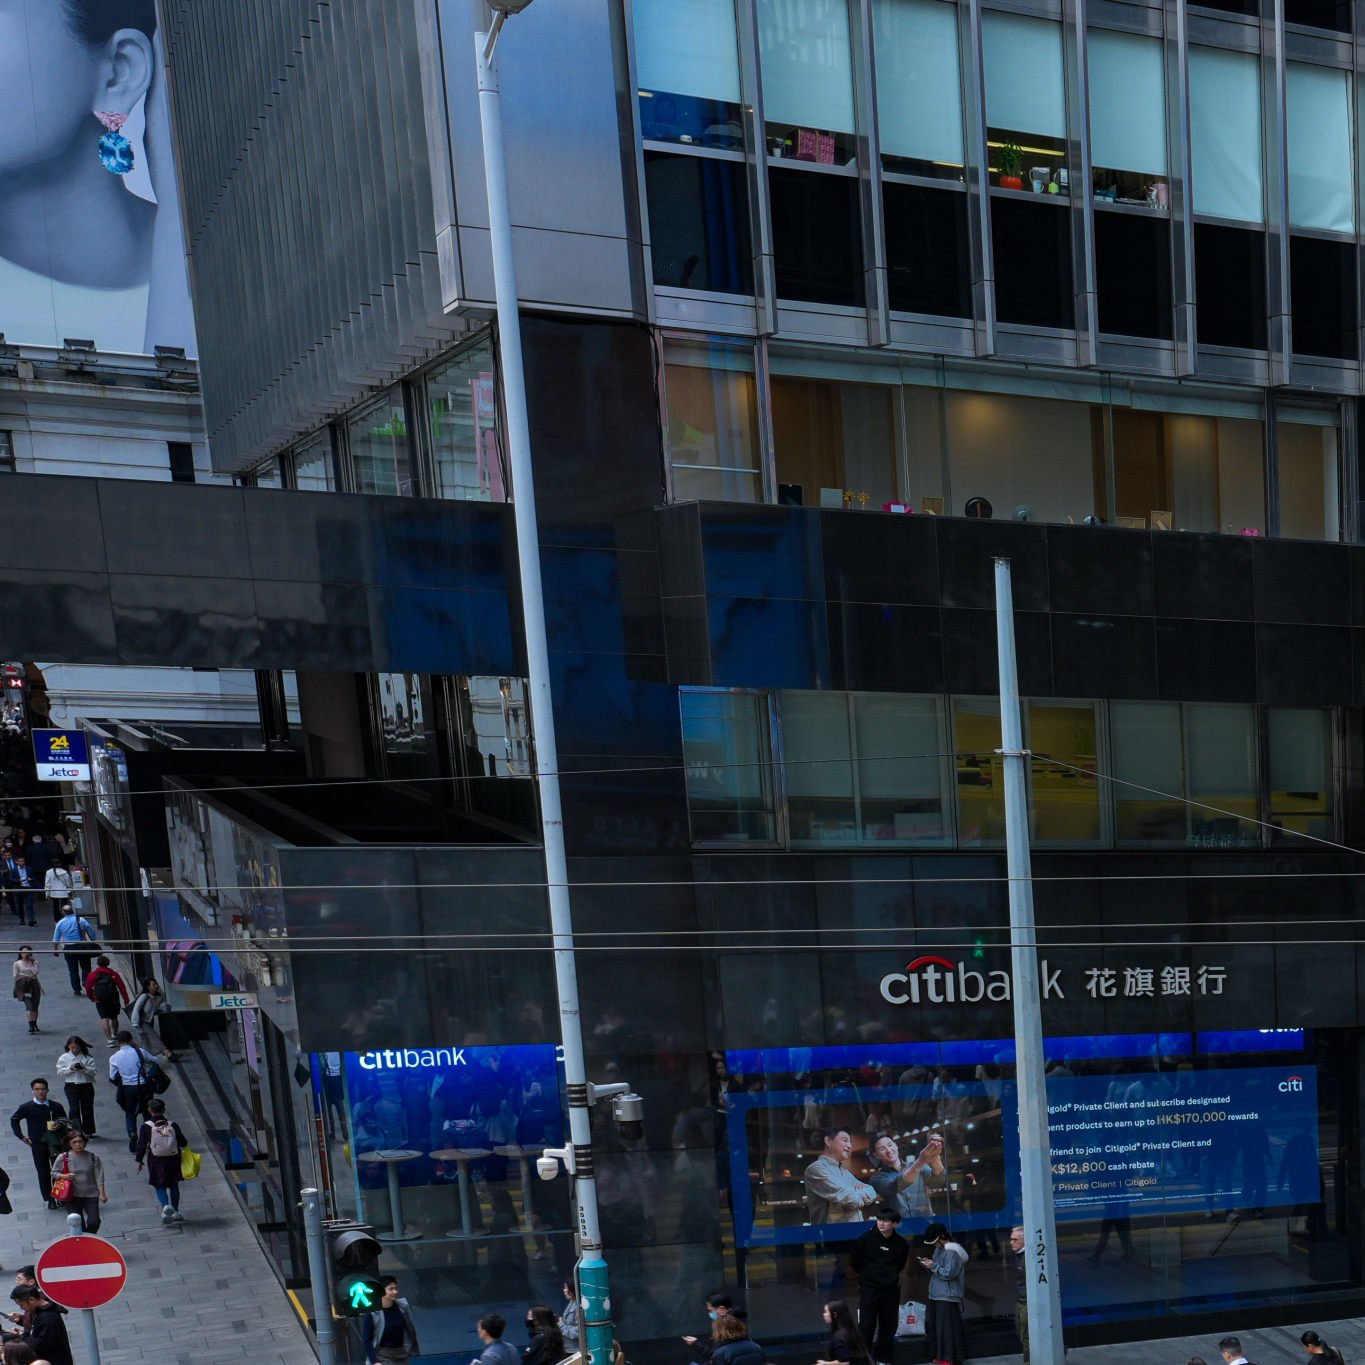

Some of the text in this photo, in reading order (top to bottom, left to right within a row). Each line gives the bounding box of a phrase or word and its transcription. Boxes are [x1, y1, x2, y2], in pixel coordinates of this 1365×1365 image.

[49, 735, 70, 749] 24
[880, 956, 1227, 1004] citibak 花旗銀行
[359, 1047, 467, 1070] citibank
[1278, 1077, 1303, 1092] citi
[1073, 1102, 1103, 1112] Private
[1103, 1101, 1128, 1110] Client
[1129, 1100, 1145, 1109] and
[1187, 1096, 1231, 1107] designated
[1066, 1120, 1103, 1132] products
[1104, 1120, 1113, 1128] to
[1114, 1120, 1133, 1128] earn
[1134, 1119, 1145, 1129] up
[1146, 1118, 1156, 1126] to
[1156, 1111, 1227, 1126] HK$170,000
[1227, 1112, 1259, 1121] rewards
[1049, 1147, 1074, 1156] friend
[1075, 1147, 1084, 1155] to
[1085, 1146, 1102, 1156] join
[1142, 1141, 1170, 1150] Private
[1171, 1139, 1195, 1149] Client
[1196, 1138, 1212, 1147] and
[1050, 1161, 1155, 1175] K$12,800 cash rebate
[1058, 1177, 1158, 1191] Private Client Citigold
